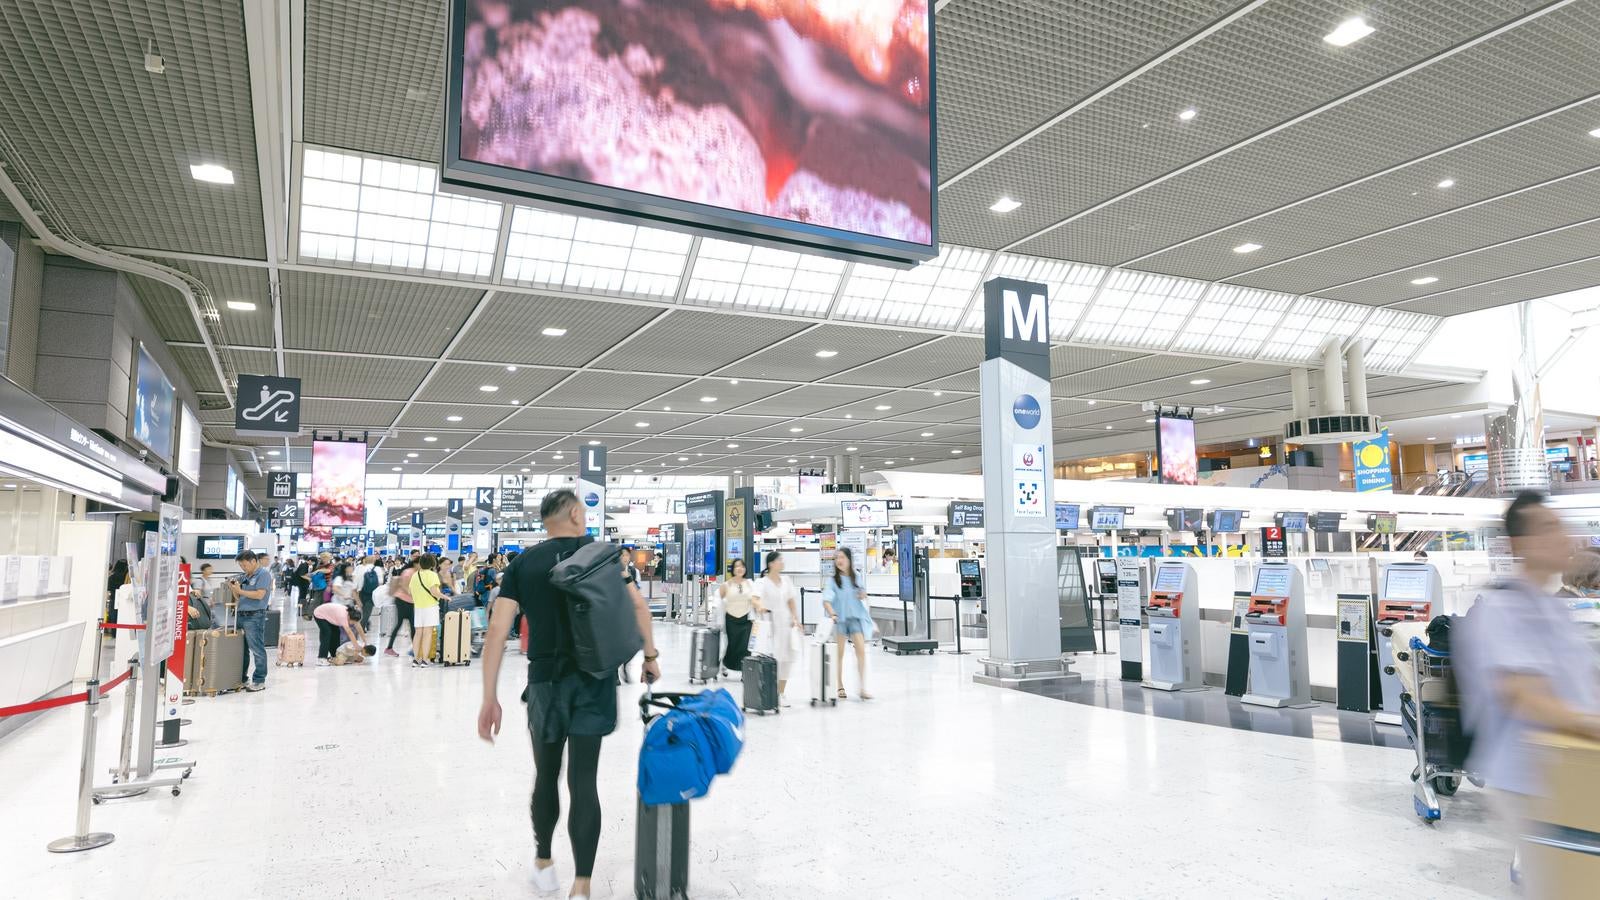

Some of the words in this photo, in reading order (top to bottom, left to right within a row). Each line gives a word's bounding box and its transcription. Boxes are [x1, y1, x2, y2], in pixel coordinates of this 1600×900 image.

[1003, 289, 1046, 343] M
[1014, 408, 1040, 416] oneworld
[588, 450, 602, 471] L
[1357, 467, 1390, 476] SHOPPING
[1361, 477, 1386, 485] DINING
[479, 489, 491, 504] K
[451, 500, 459, 513] J
[889, 501, 900, 509] M1
[390, 522, 398, 531] H
[1270, 528, 1279, 538] 2
[177, 570, 188, 596] 入口
[174, 600, 185, 641] ENTRANCE
